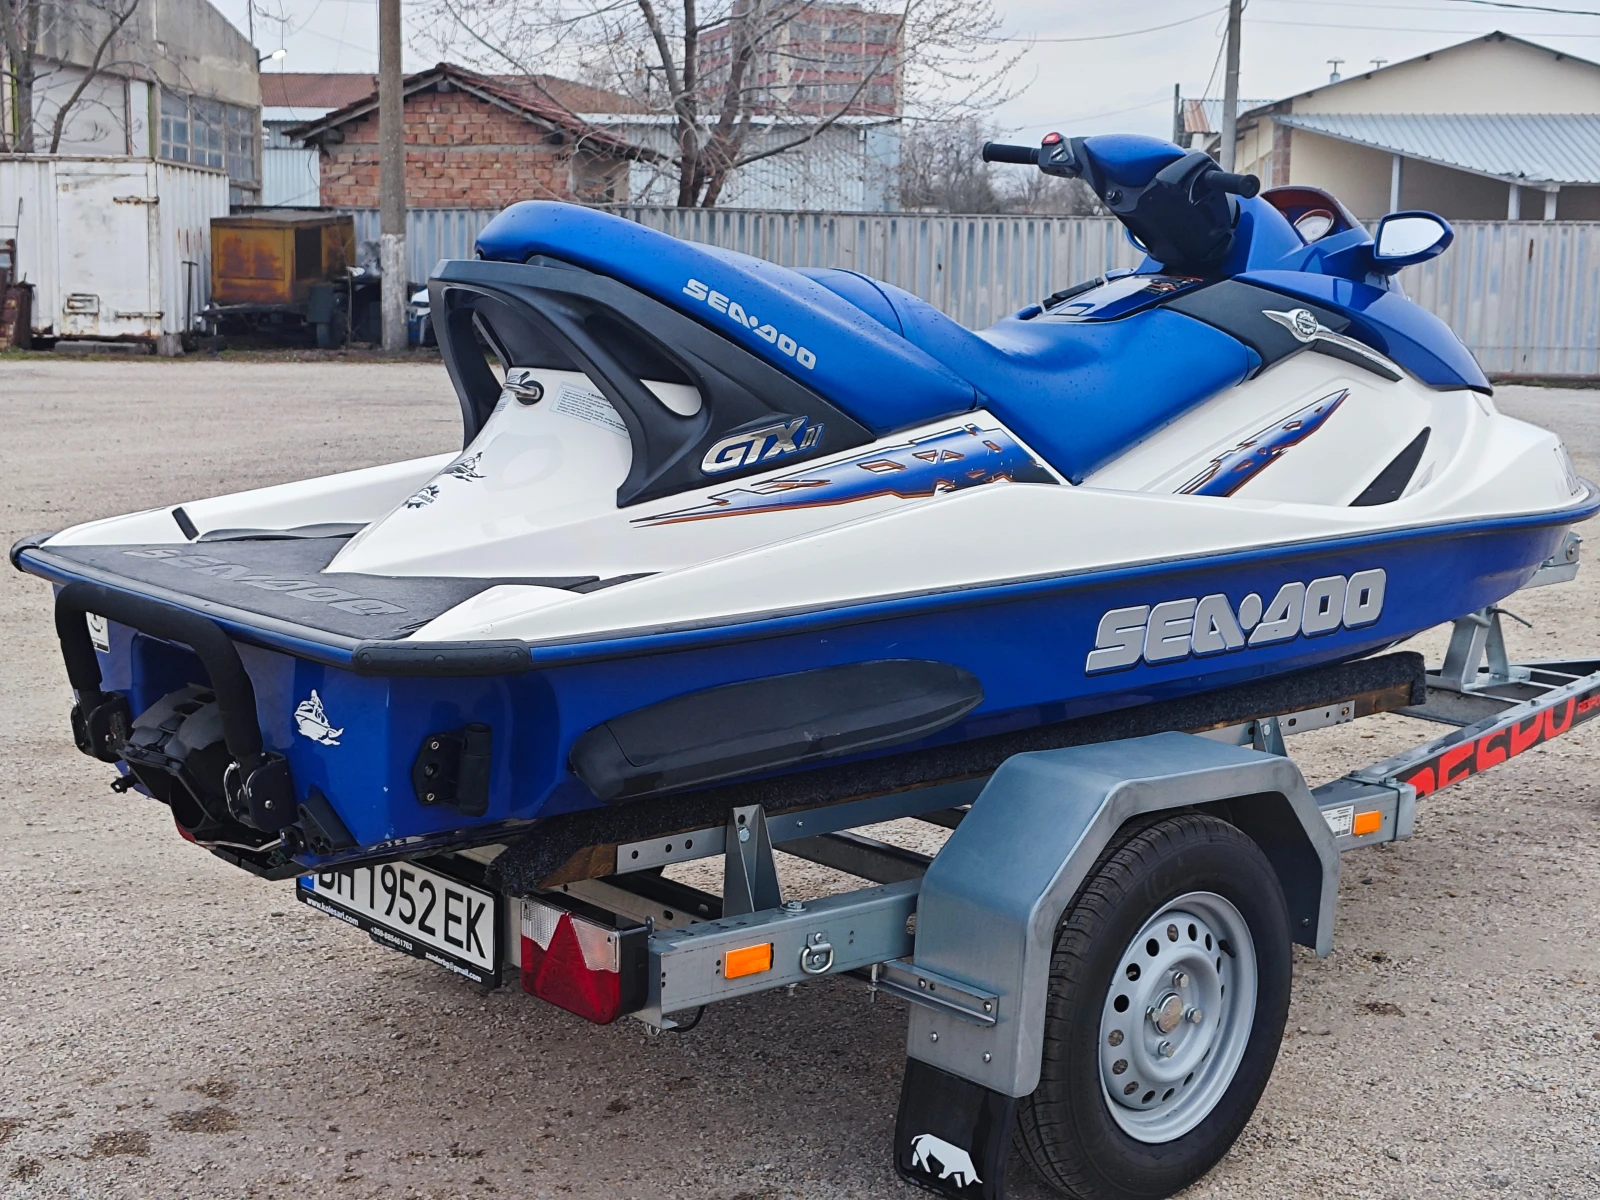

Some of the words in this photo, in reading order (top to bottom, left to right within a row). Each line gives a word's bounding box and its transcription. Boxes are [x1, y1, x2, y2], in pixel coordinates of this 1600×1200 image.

[701, 417, 807, 473] GTX
[366, 864, 437, 937] 1952
[444, 888, 487, 959] EK
